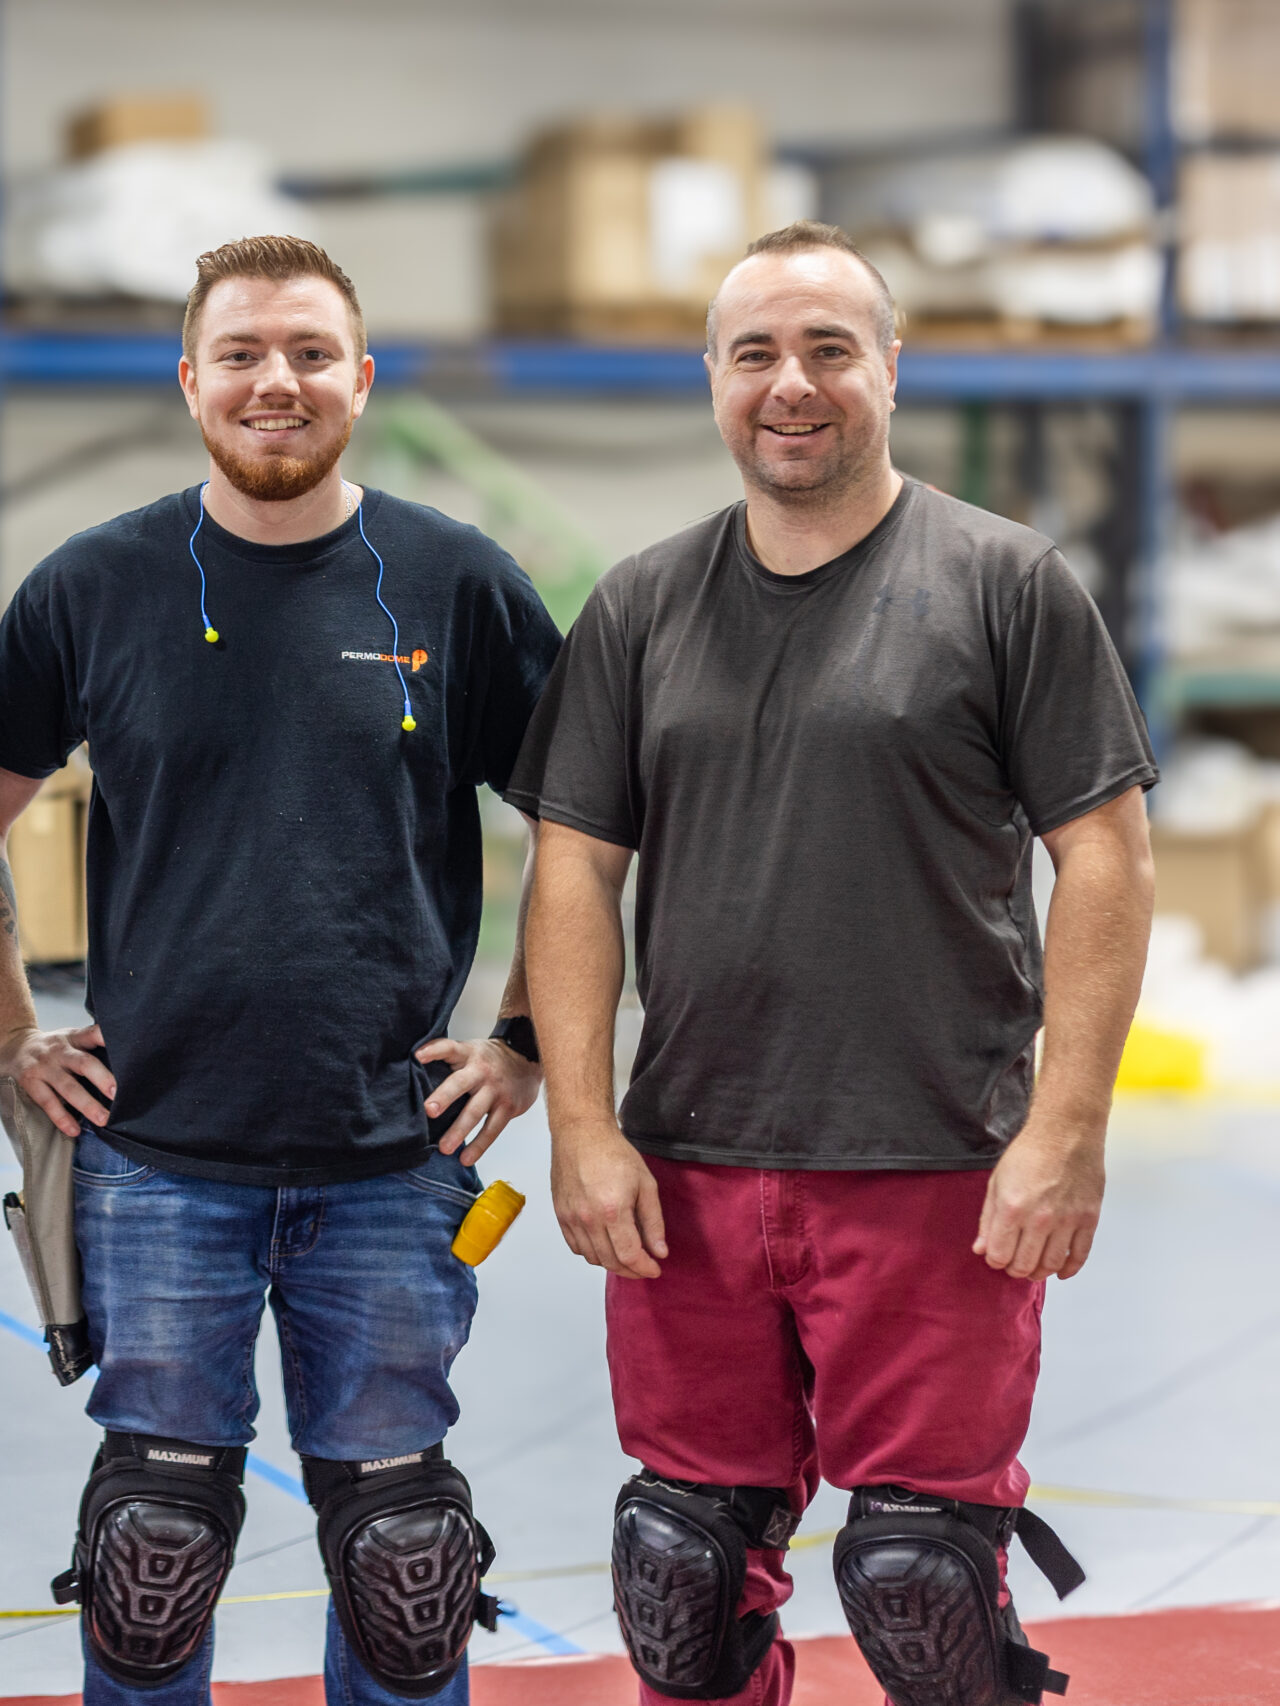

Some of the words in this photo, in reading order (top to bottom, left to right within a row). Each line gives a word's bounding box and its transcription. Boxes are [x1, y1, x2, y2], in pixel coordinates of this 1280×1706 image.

[341, 651, 411, 664] PERMODOME
[147, 1448, 214, 1466] MAXIMUM
[361, 1452, 424, 1473] MAXIMUM
